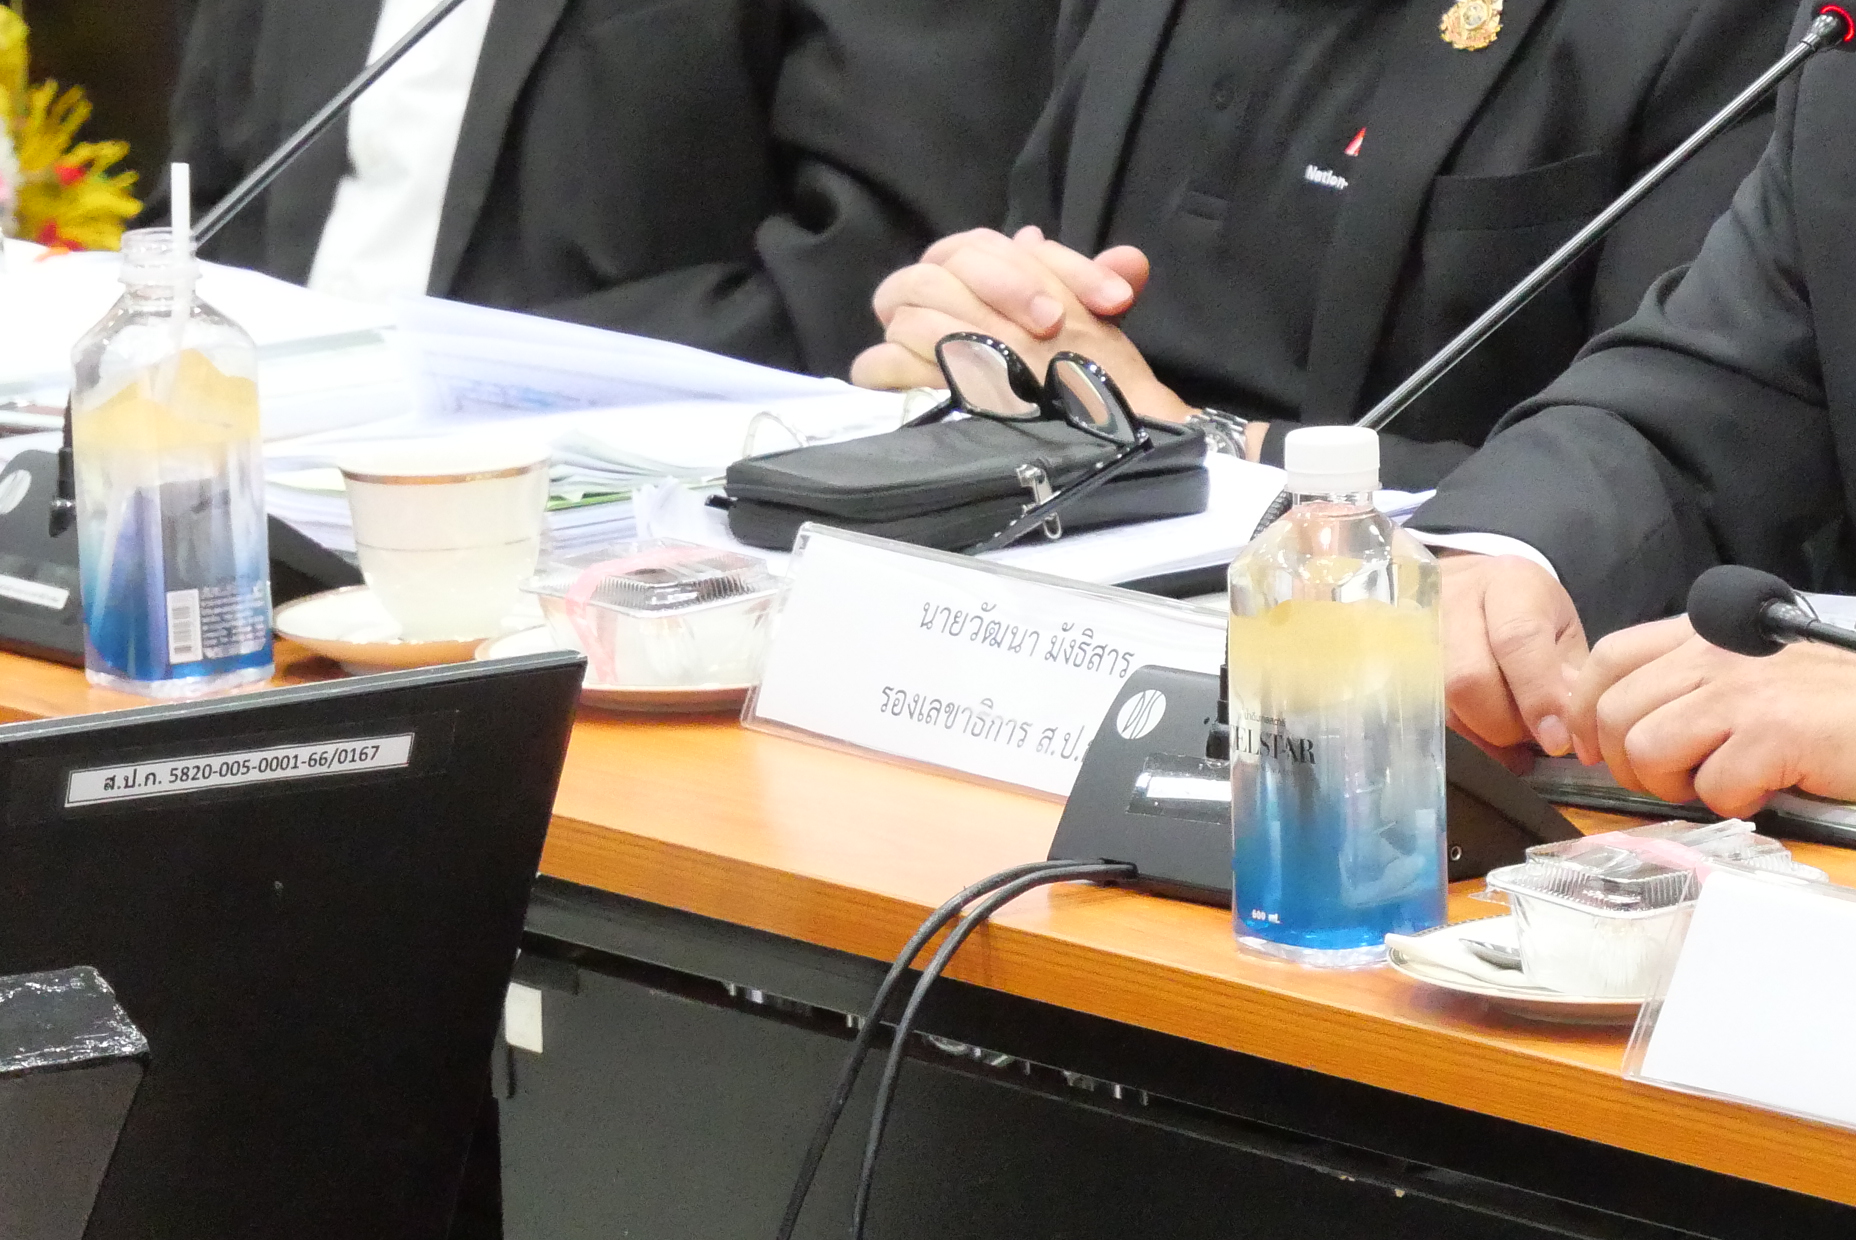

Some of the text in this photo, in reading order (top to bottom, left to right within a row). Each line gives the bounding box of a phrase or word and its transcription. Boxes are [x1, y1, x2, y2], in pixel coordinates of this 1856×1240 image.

[919, 601, 1136, 679] นายวัฒนา มังธิสาร
[879, 685, 1093, 763] รองเลขาธิการ ส.ป.
[102, 744, 381, 792] ส.ป.ก. 5820-005-0001-66/0167
